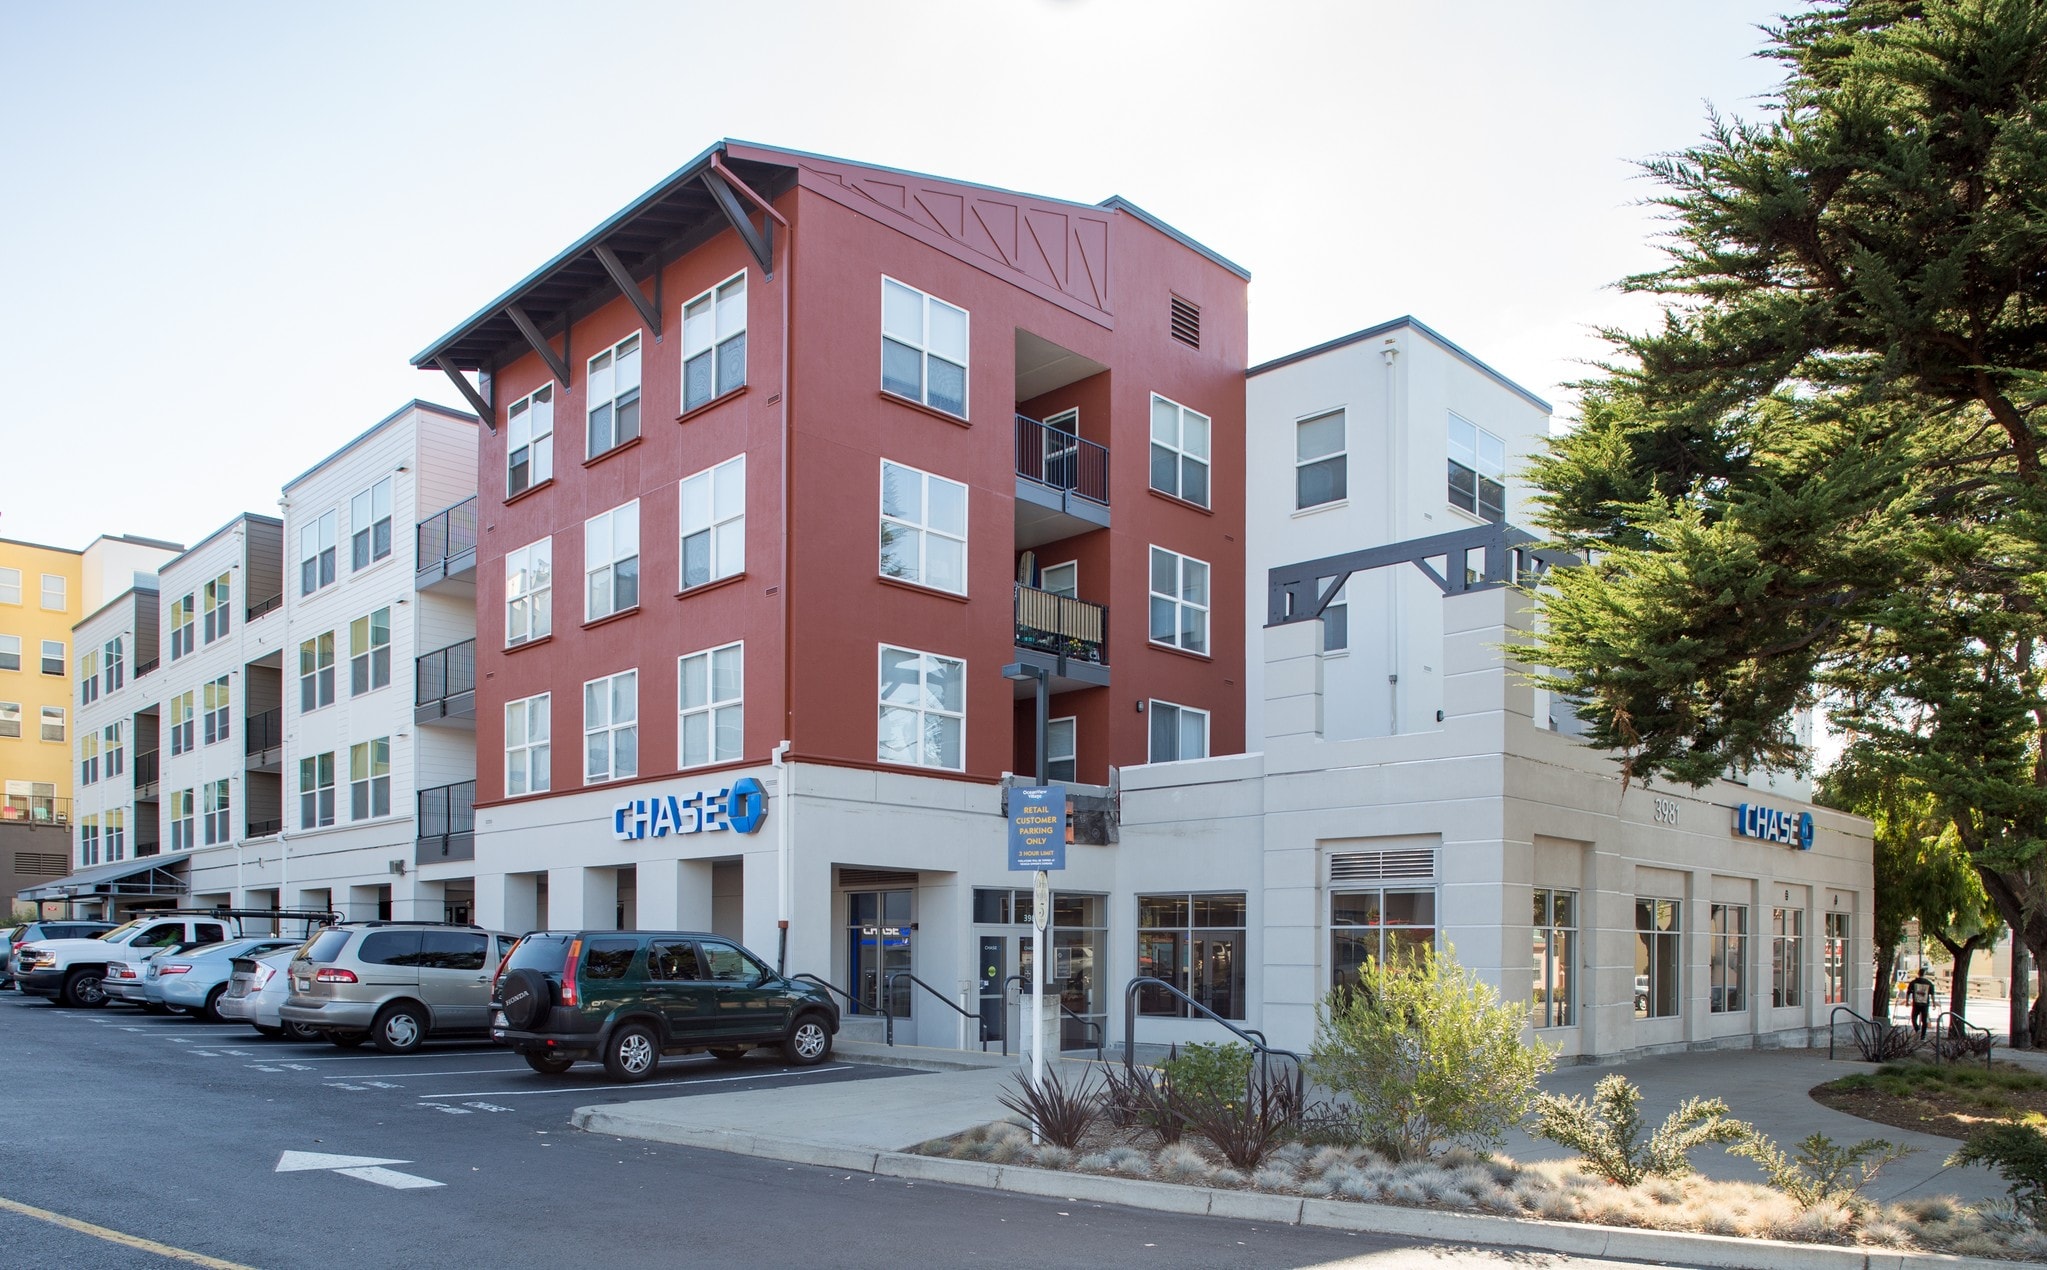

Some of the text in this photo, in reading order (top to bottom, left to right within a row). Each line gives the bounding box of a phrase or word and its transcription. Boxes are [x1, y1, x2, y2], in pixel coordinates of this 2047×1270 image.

[612, 788, 729, 841] CHASE
[1023, 806, 1049, 814] RETAIL
[1654, 798, 1681, 825] 3981
[1015, 816, 1057, 825] CUSTOMER
[1744, 803, 1800, 846] CHASE
[1019, 826, 1053, 835] PARKING
[1025, 837, 1047, 845] ONLY
[505, 990, 530, 1007] HONDA
